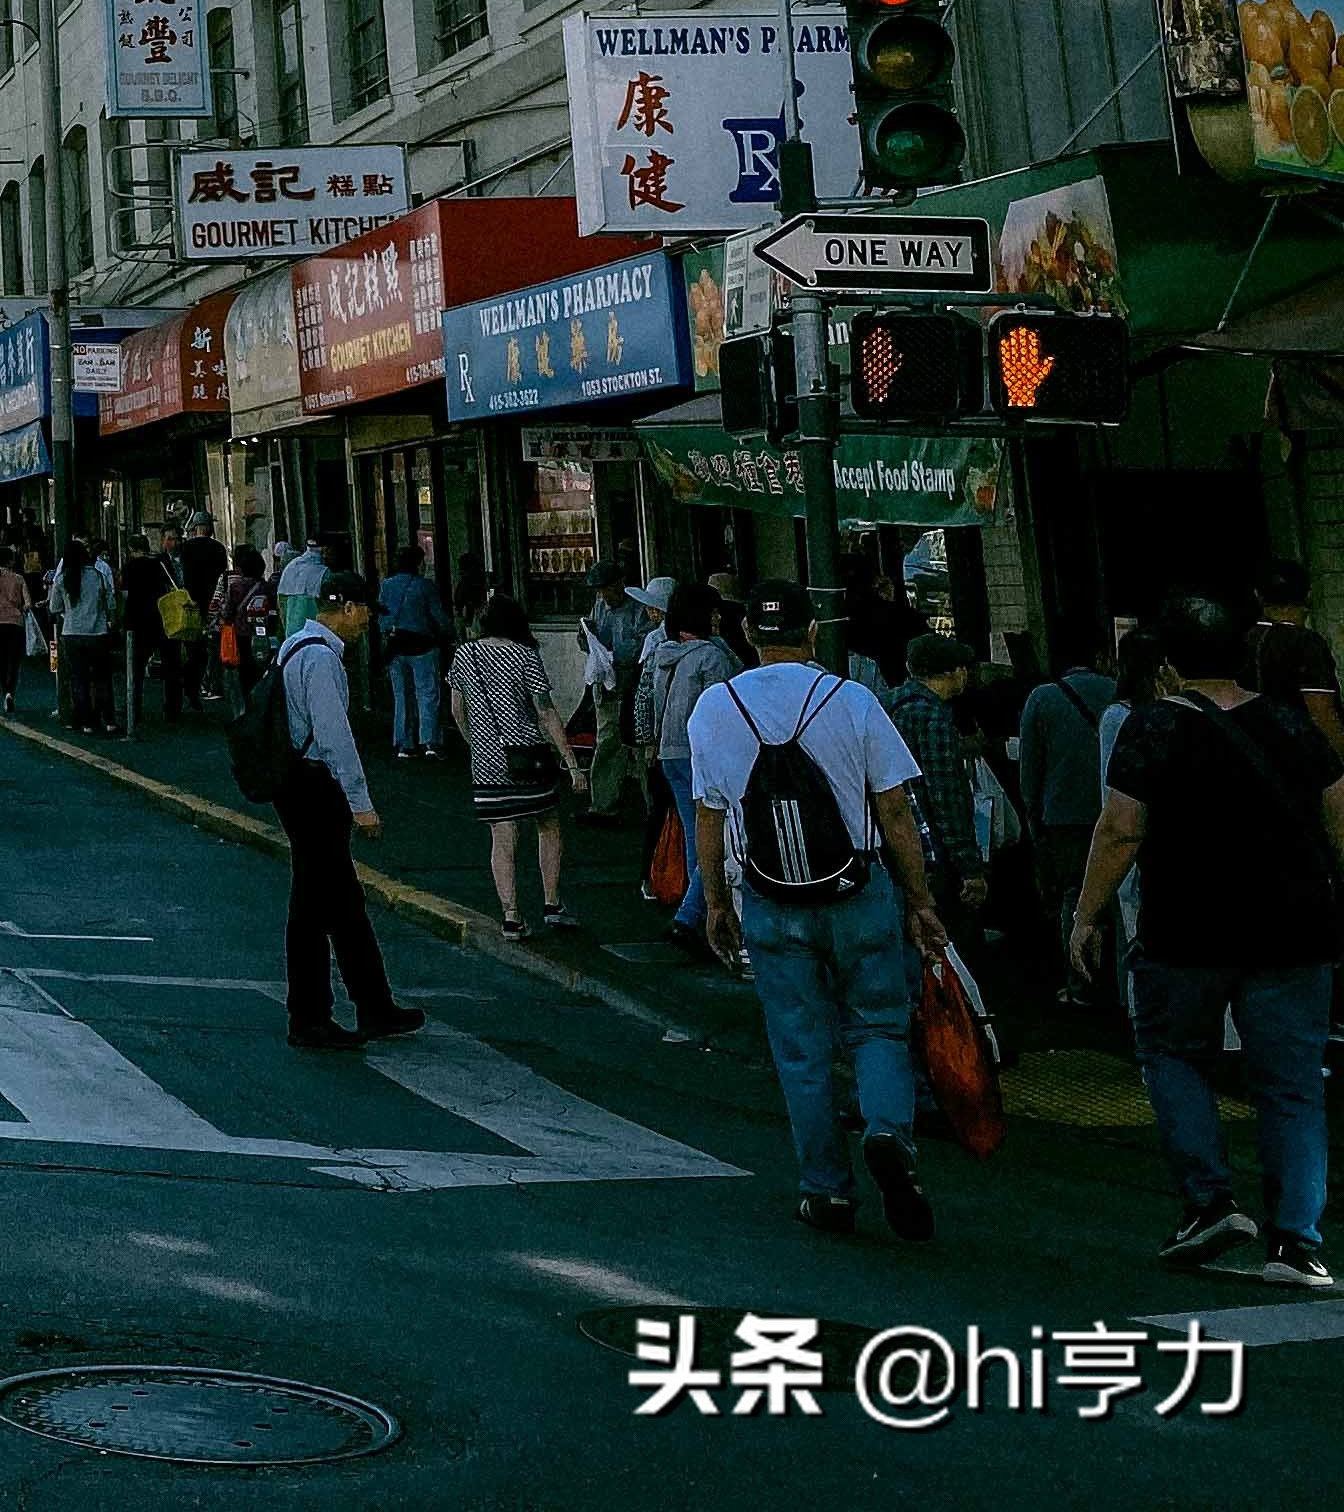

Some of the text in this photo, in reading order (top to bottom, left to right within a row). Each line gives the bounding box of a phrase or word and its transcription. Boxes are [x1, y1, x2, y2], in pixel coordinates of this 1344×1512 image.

[597, 27, 750, 56] WELLMAN'S
[617, 71, 687, 213] 康健
[188, 160, 395, 203] 威記 糕點
[192, 219, 298, 248] GOURMET
[825, 239, 964, 268] ONE WAY
[480, 264, 652, 337] WELLMAN'S PHARMACY
[73, 346, 86, 354] NO
[330, 333, 370, 373] GOURMET
[371, 320, 411, 361] KITCHEN
[582, 367, 663, 396] 1053 STOCKTON ST.
[833, 460, 956, 501] Accept Food Stamp
